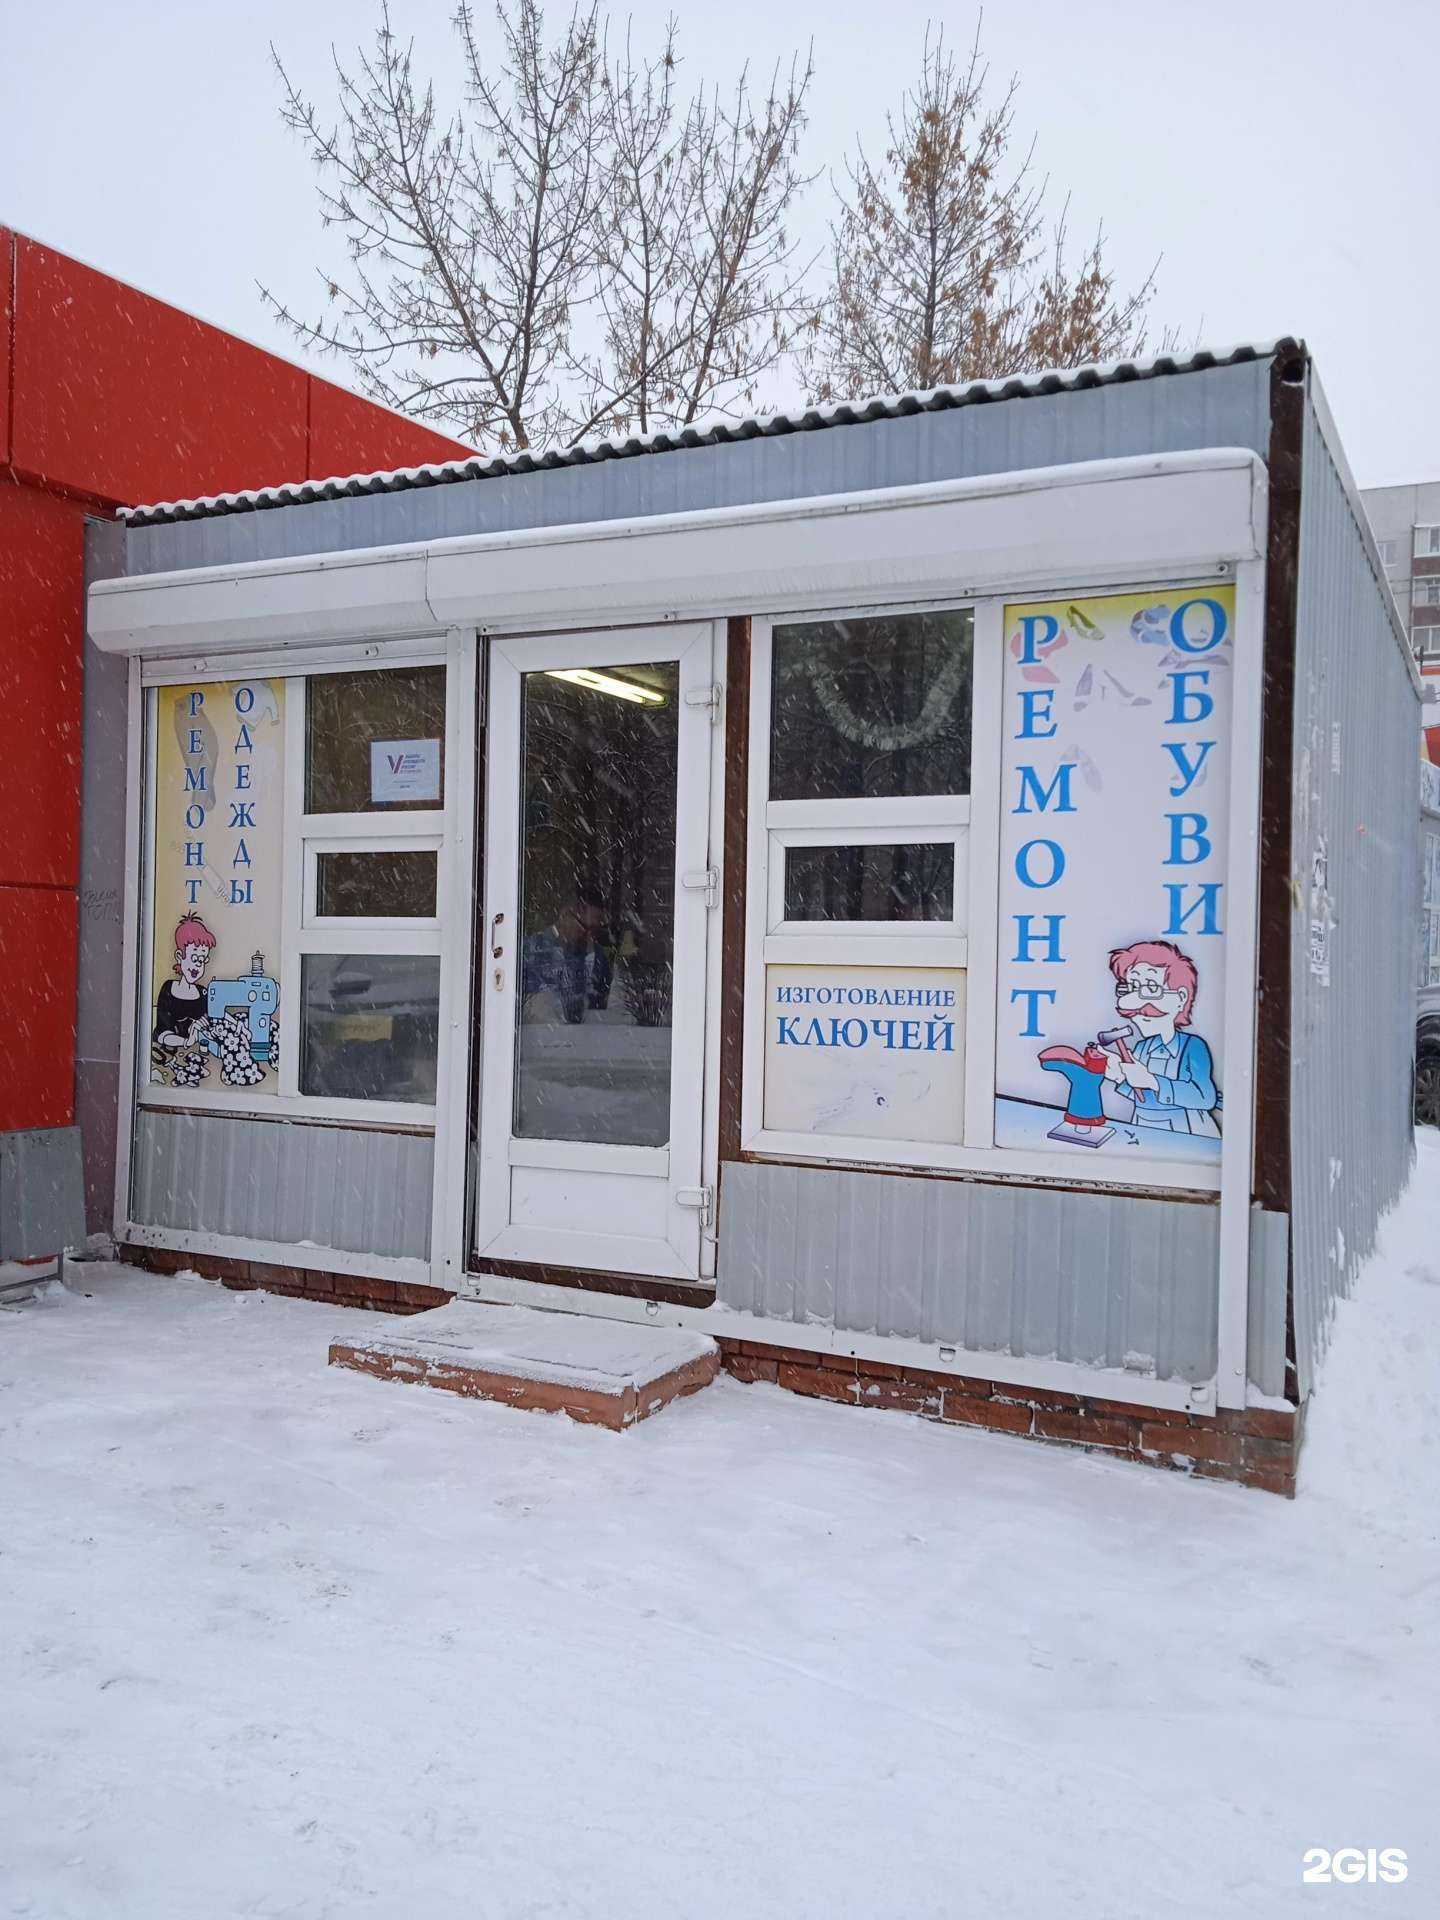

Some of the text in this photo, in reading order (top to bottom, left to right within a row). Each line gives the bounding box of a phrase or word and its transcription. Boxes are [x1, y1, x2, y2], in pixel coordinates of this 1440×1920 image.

[184, 692, 207, 903] РЕМОНТ
[229, 688, 256, 904] ОДЕЖДЫ
[1011, 615, 1077, 1037] РЕМОНТ
[1161, 599, 1227, 936] ОБУВИ
[776, 986, 956, 1009] ИЗГОТОВЛЕНИЕ
[776, 1013, 956, 1054] КЛЮЧЕЙ
